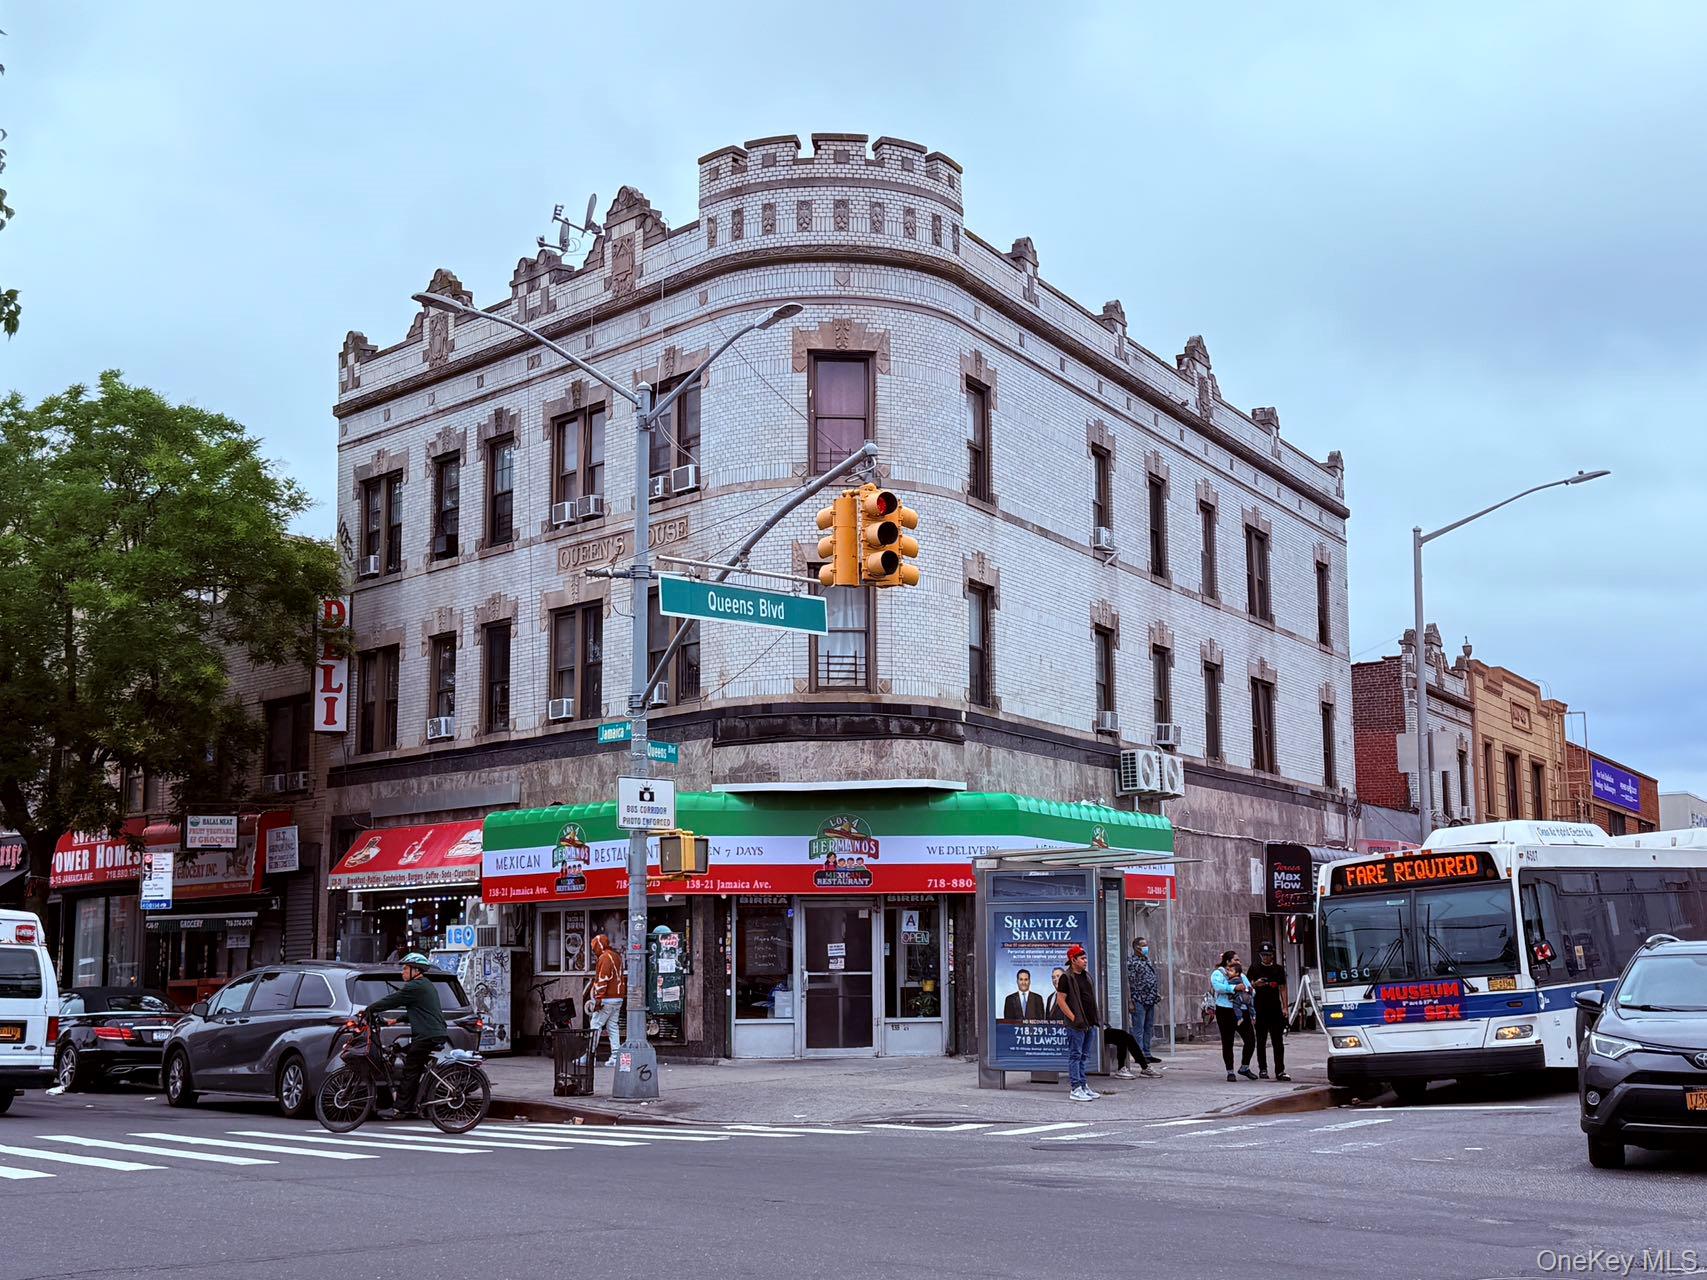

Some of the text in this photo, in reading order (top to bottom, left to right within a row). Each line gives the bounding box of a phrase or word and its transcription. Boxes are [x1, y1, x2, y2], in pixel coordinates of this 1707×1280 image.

[561, 520, 688, 569] QUEEN'S OUSE
[708, 591, 784, 620] Queens Blvd
[600, 725, 625, 741] Jamaica
[648, 743, 676, 759] Queens Blvd
[627, 805, 667, 815] BUS CORRIDOR
[623, 817, 670, 827] PHOTO ENFORCED
[829, 817, 848, 826] LOS
[725, 849, 732, 858] 7
[736, 846, 764, 856] DAYS
[812, 840, 876, 854] HERMANOS
[926, 846, 944, 855] WE
[51, 849, 90, 873] OWER
[496, 854, 541, 870] MEXICAN
[1273, 872, 1301, 880] Max
[1346, 854, 1479, 886] FARE REQUIRED
[509, 887, 534, 898] Jamaica
[536, 885, 549, 894] Ave.
[686, 879, 772, 891] 138-21 Jamaica Ave.
[180, 919, 204, 928] GROCERY
[906, 914, 916, 926] A
[1004, 915, 1079, 929] SHAEVITZ &
[902, 932, 929, 944] OPEN
[1012, 928, 1072, 941] SHAEVITZ
[1380, 982, 1460, 1001] MUSEUM
[1383, 1004, 1462, 1023] OF SEX
[1016, 1036, 1032, 1045] 718
